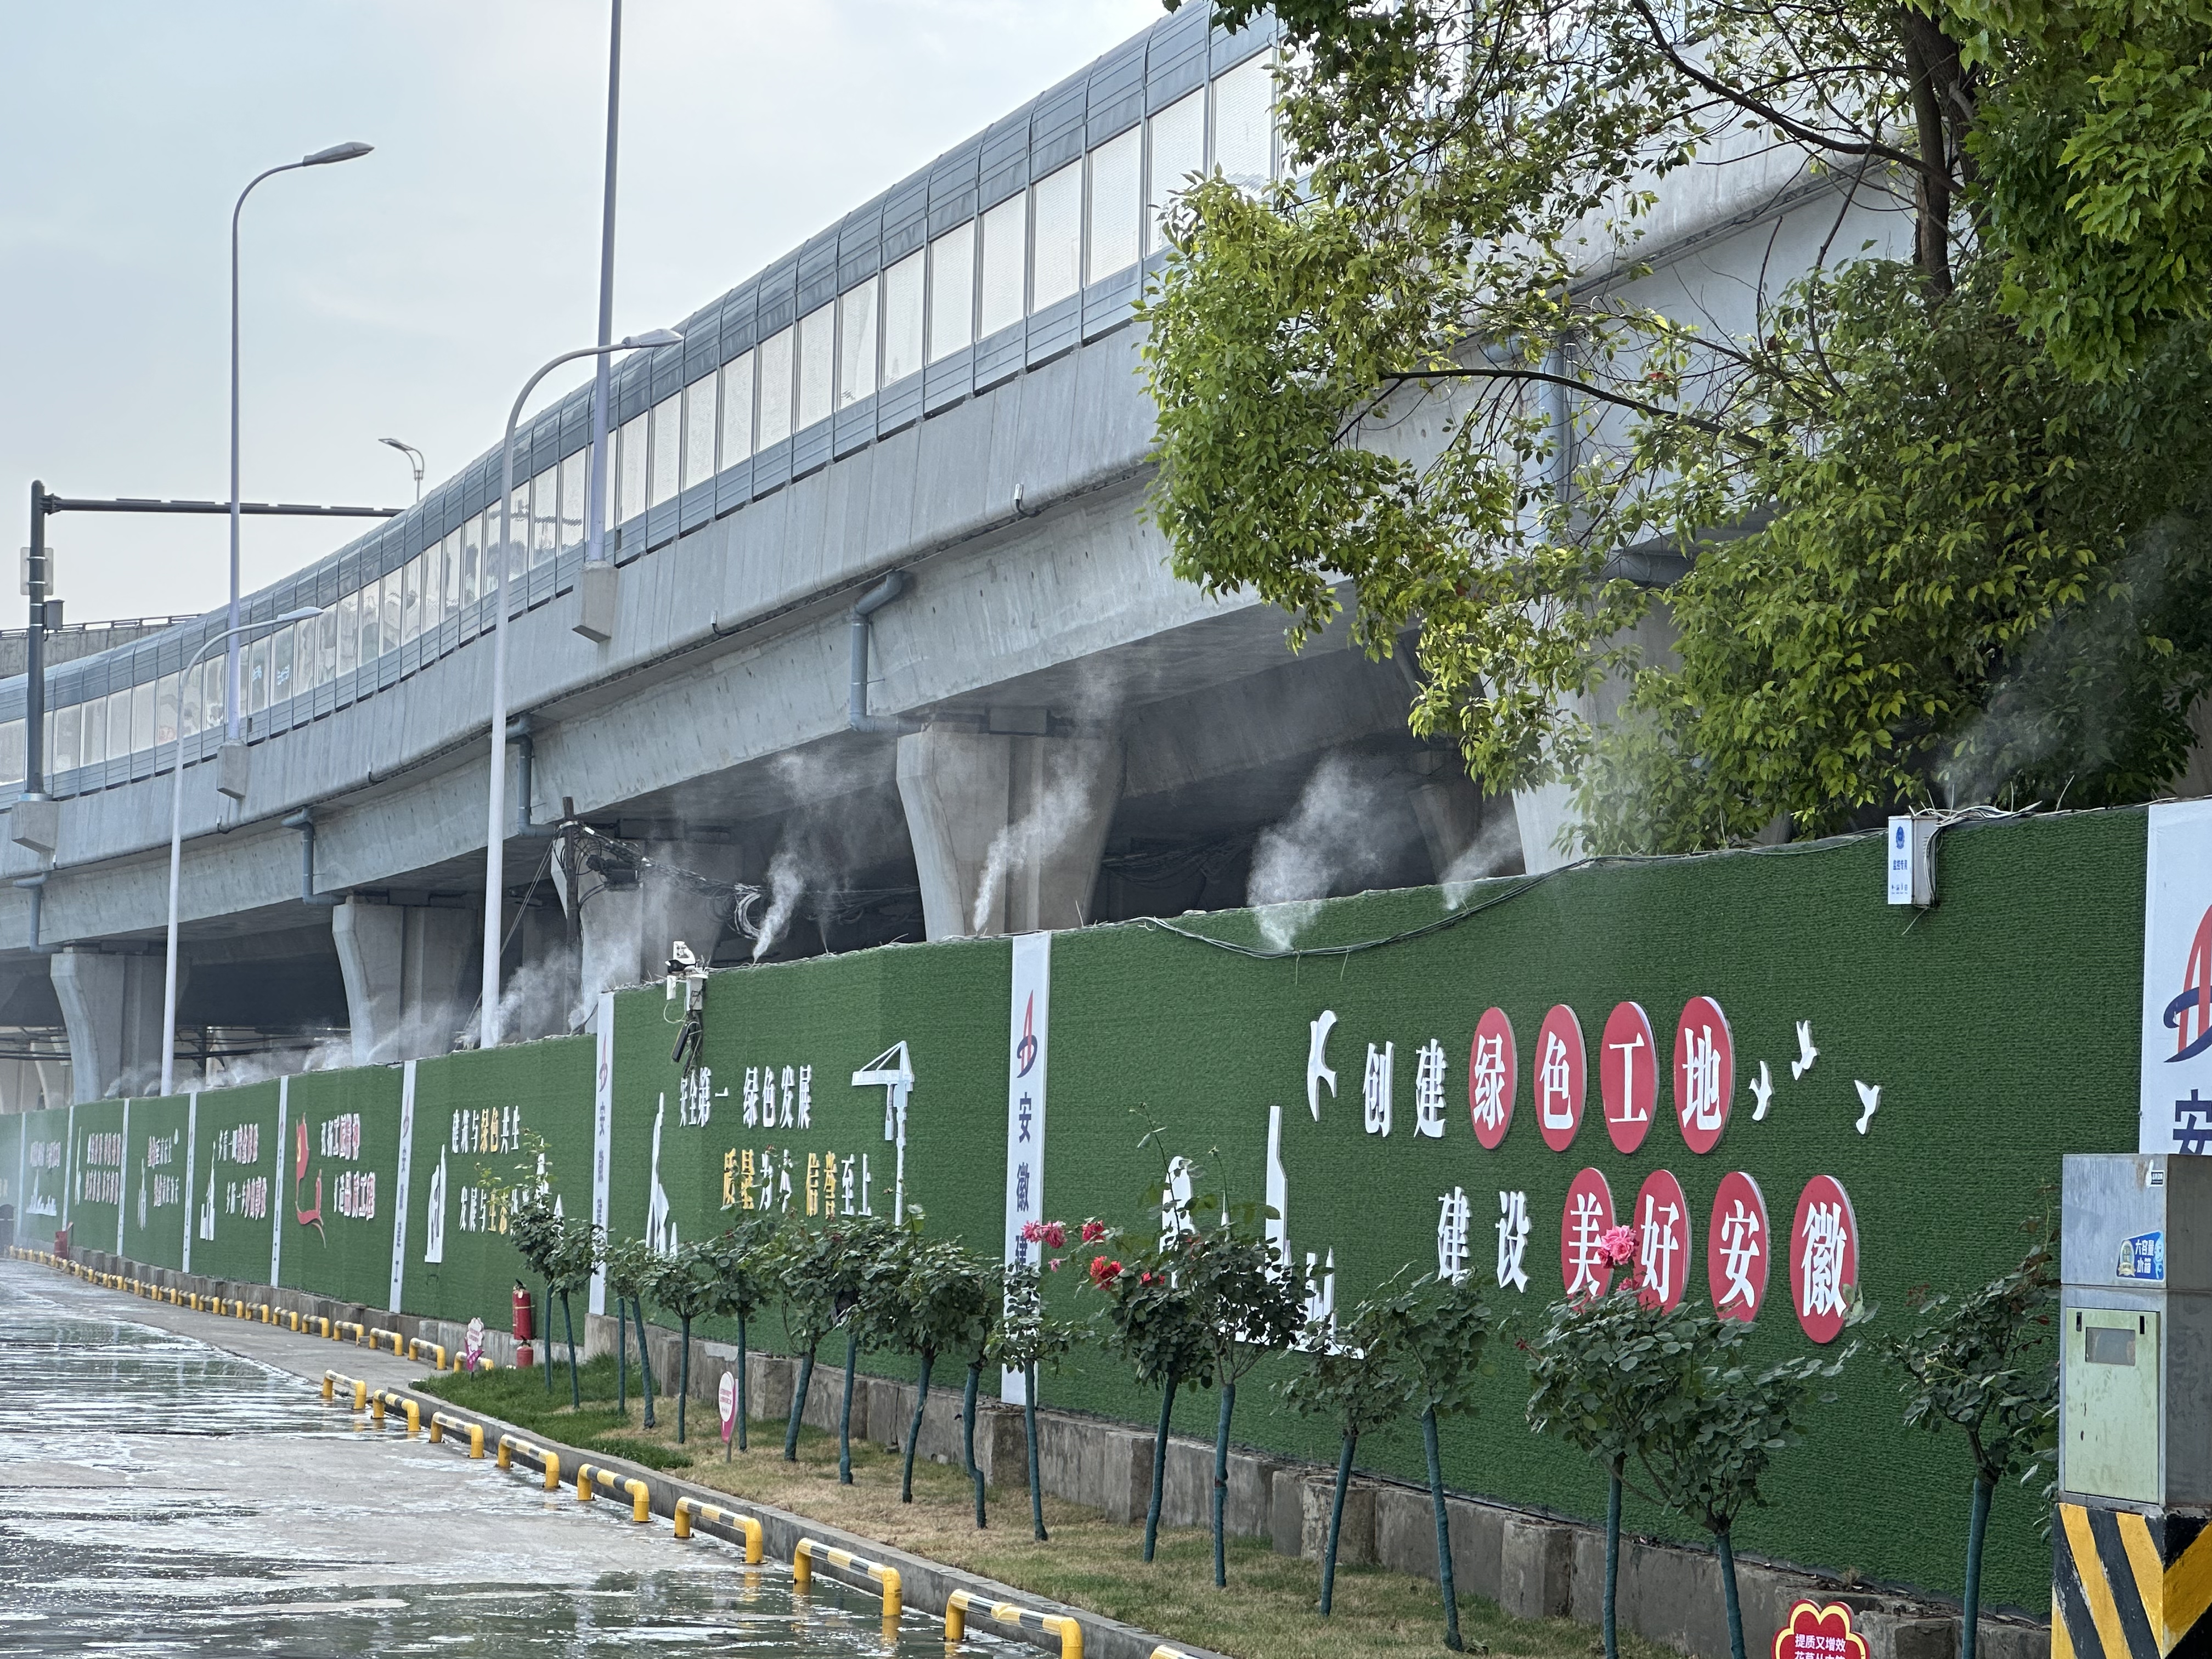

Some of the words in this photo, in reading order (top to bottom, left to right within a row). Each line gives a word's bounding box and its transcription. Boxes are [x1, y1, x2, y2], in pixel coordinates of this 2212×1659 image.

[679, 1066, 729, 1127] 安全第一
[743, 1065, 812, 1129] 绿色发展
[1363, 1024, 1723, 1138] 创建绿色工地
[452, 1105, 521, 1155] 建筑与绿色共生
[806, 1151, 872, 1219] 信誉至上
[1438, 1186, 1847, 1318] 建设美好安徽
[2135, 1239, 2154, 1256] 大容量
[2137, 1257, 2151, 1274] 水箱
[1795, 1633, 1846, 1653] 提质又增效
